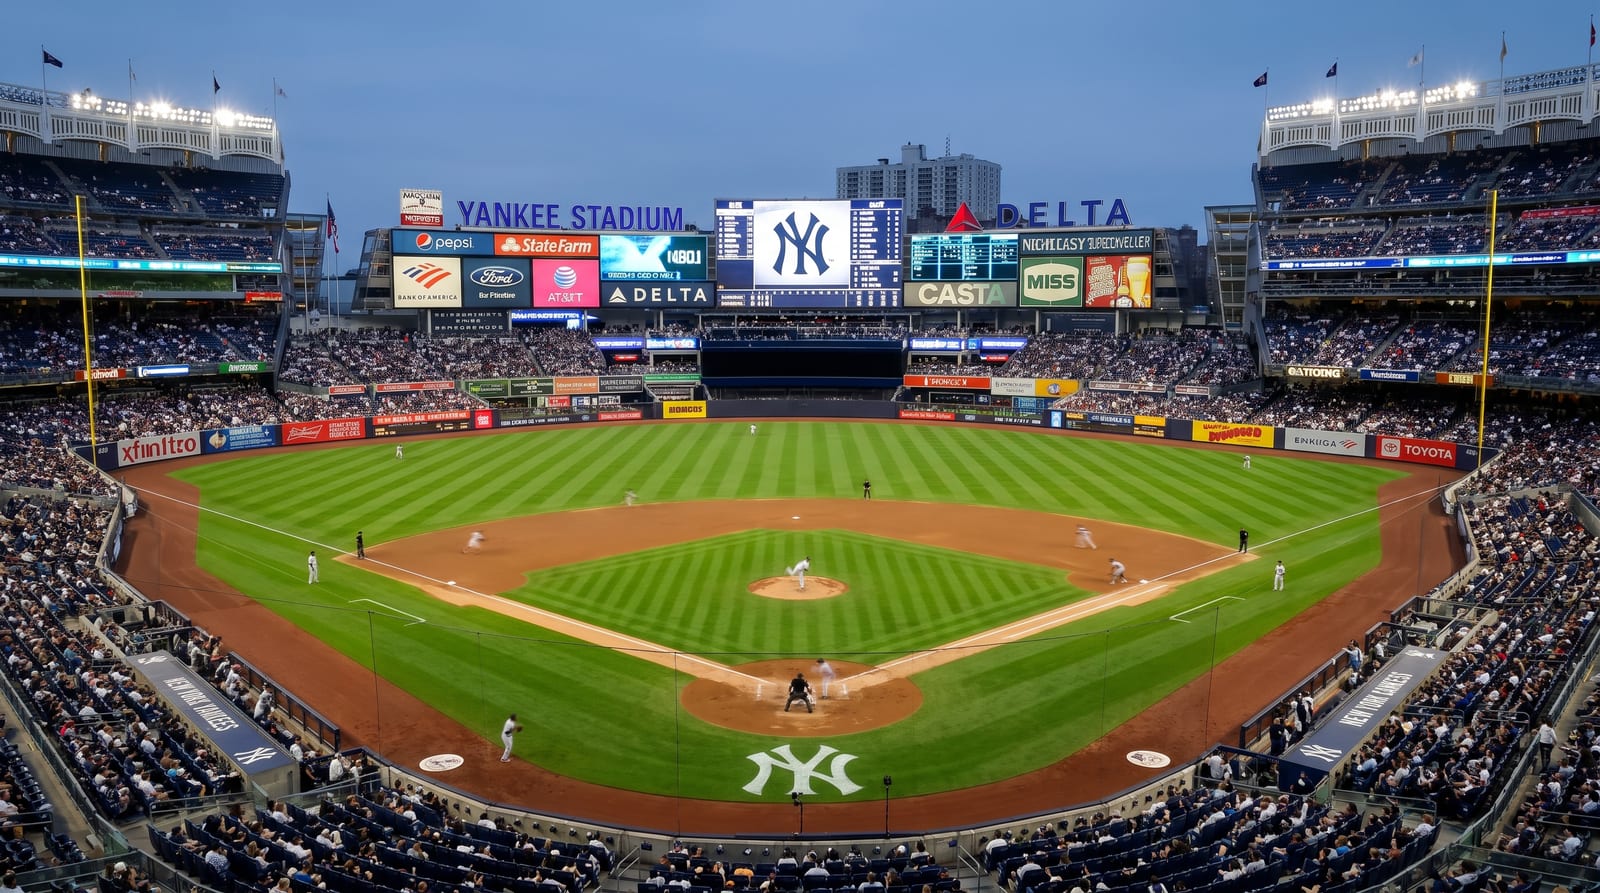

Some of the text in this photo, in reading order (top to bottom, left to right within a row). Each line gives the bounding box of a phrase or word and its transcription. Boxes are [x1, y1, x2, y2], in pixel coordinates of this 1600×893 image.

[456, 200, 684, 231] YANKEE STADIUM
[997, 198, 1132, 228] DELTA
[435, 237, 473, 251] pepsi
[480, 269, 513, 284] Ford
[1027, 274, 1075, 289] MISS
[634, 287, 707, 302] DELTA
[918, 282, 1006, 304] CASTA
[1404, 444, 1453, 460] TOYOTA
[742, 744, 864, 796] NY
